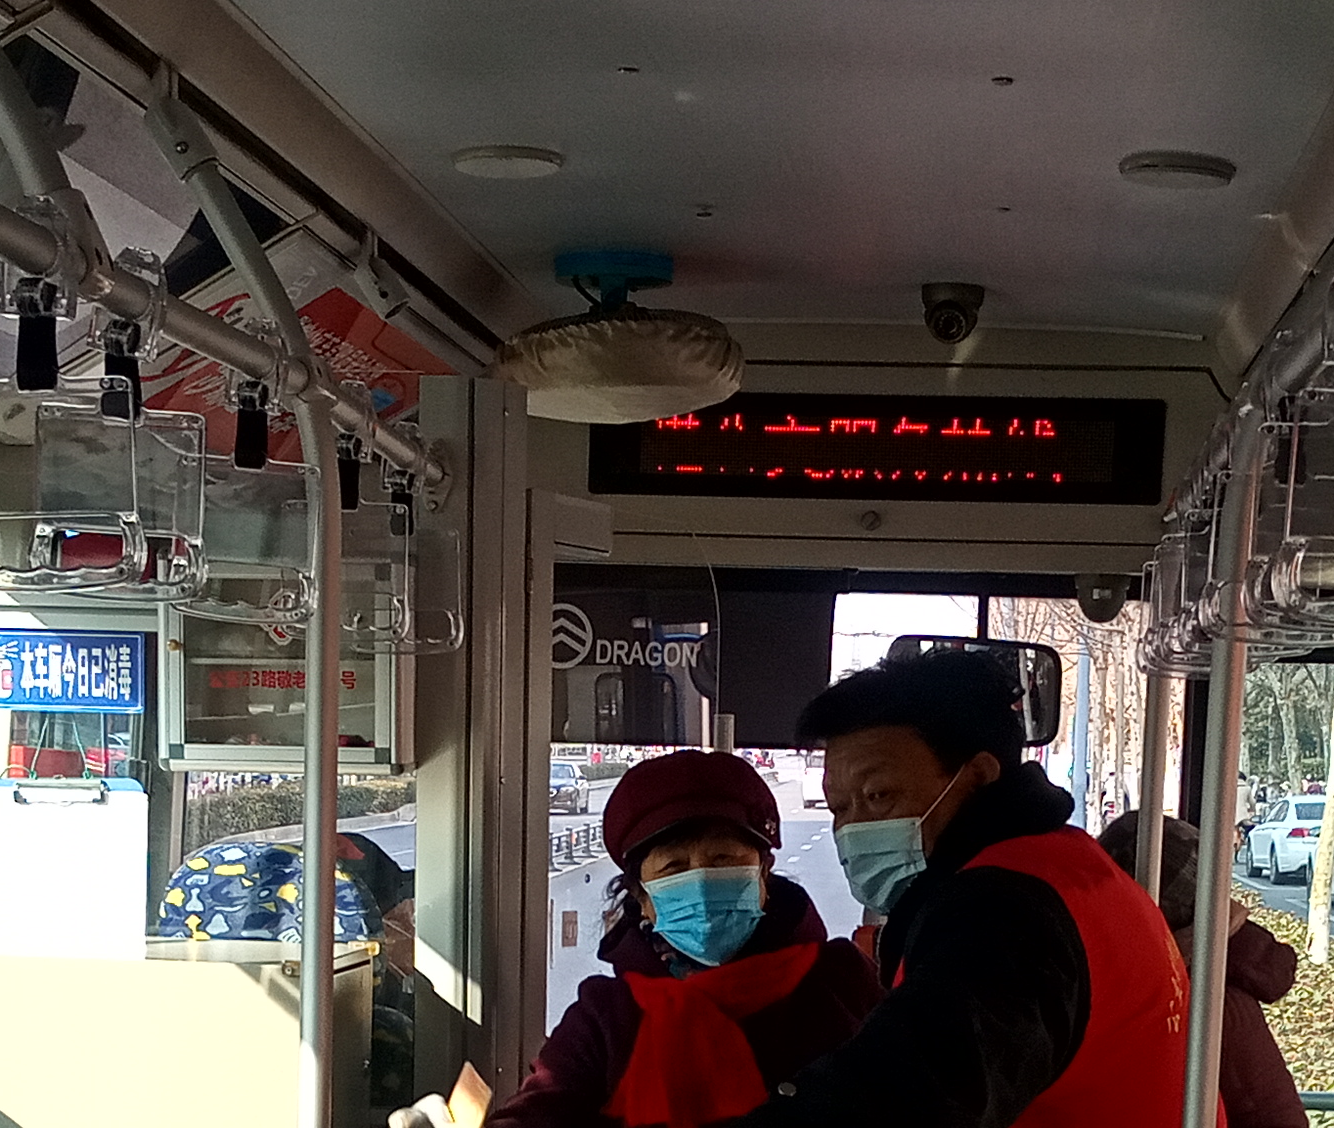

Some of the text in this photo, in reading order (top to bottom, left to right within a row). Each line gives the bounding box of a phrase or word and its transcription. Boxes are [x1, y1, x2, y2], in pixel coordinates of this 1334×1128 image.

[595, 638, 702, 668] DRAGON
[19, 639, 133, 702] 本车厢今日已消毒
[208, 669, 358, 691] 公23路敬老号
